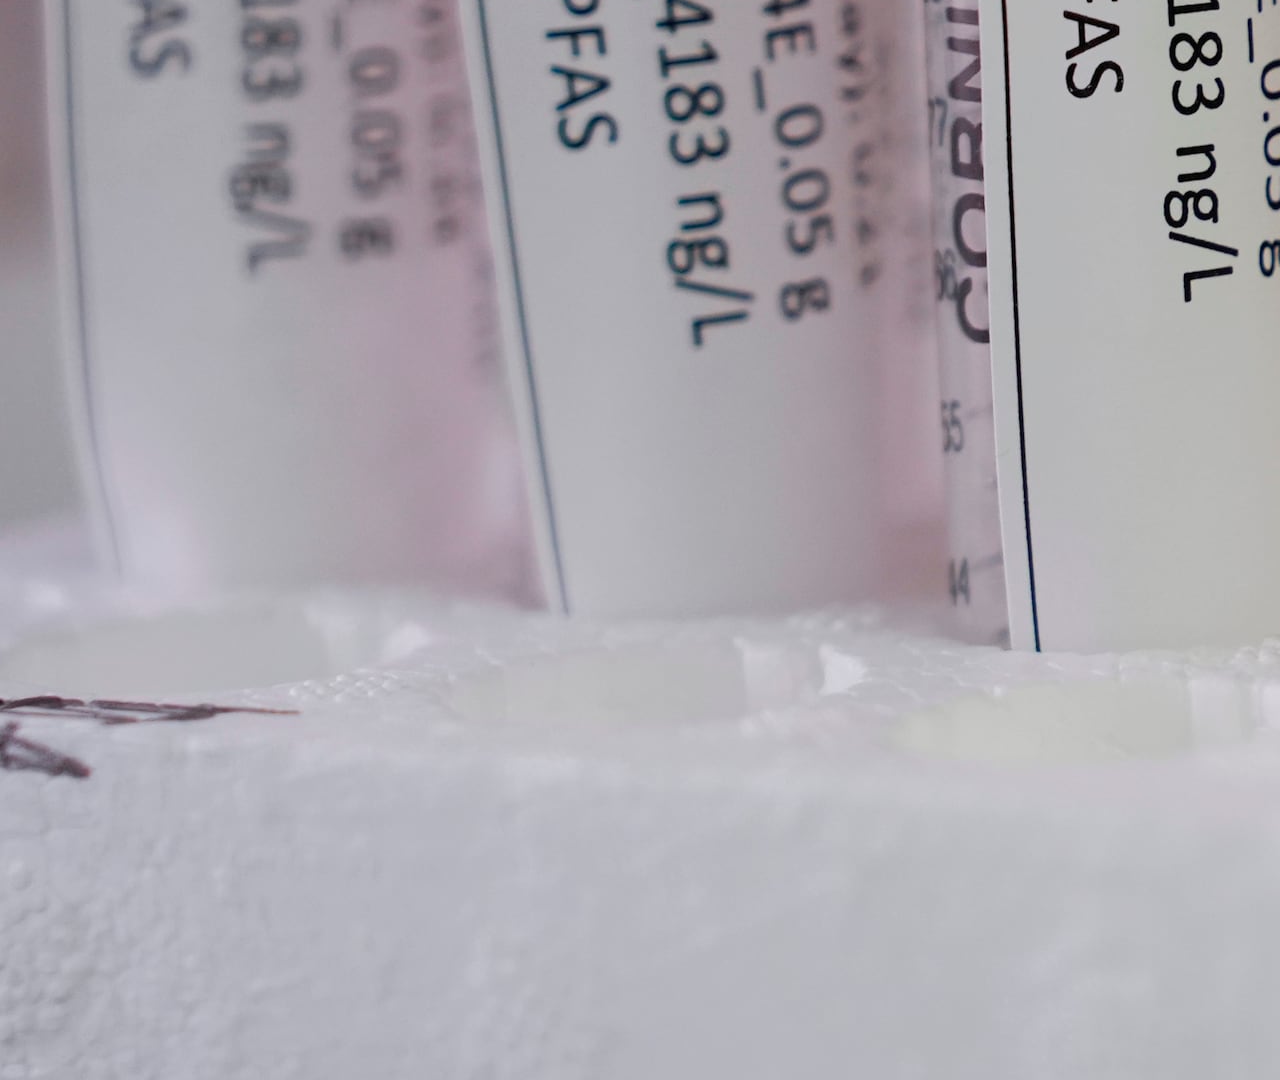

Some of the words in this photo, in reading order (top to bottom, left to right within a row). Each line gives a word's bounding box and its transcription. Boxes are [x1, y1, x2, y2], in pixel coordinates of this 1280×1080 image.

[230, 121, 310, 274] ng/L
[667, 193, 754, 348] ng/L
[1163, 143, 1239, 303] ng/L
[779, 279, 831, 320] g
